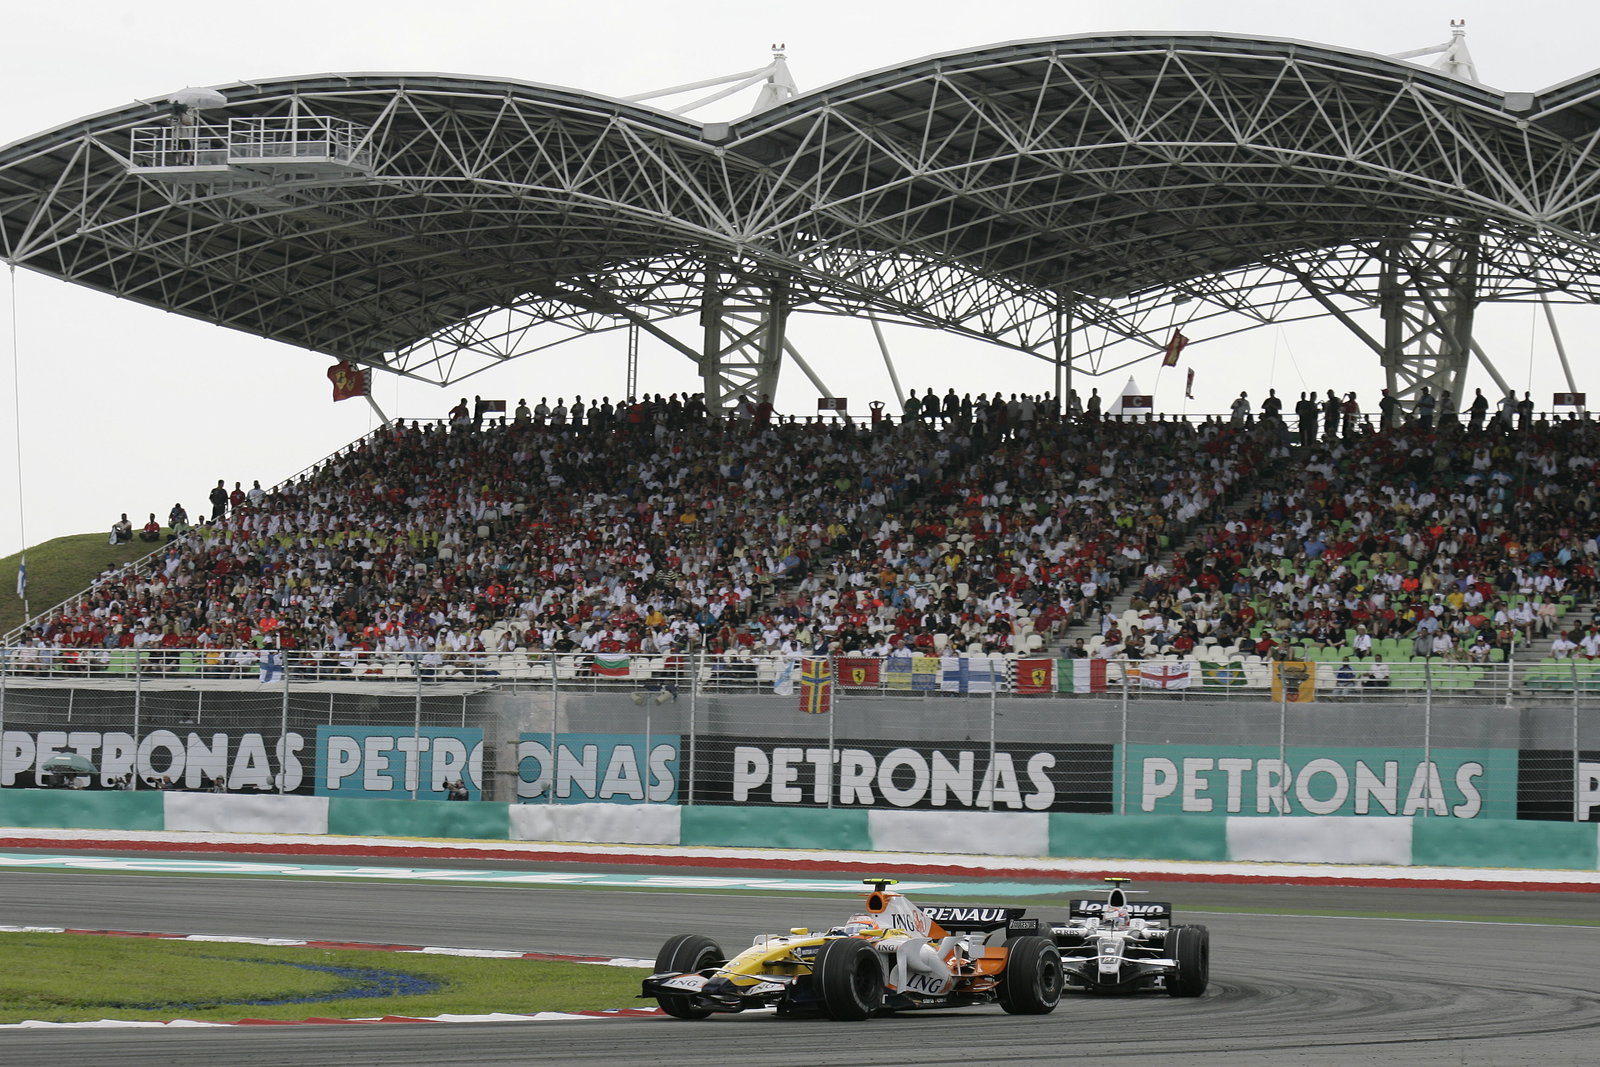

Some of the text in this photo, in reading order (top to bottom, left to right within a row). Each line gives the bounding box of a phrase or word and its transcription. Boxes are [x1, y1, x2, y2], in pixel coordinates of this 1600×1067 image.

[828, 399, 837, 409] B
[1133, 396, 1143, 407] C
[1564, 394, 1575, 405] D
[488, 401, 497, 411] A
[1, 730, 304, 793] PETRONAS
[732, 745, 1057, 810] PETRONAS
[1141, 756, 1484, 819] PETRONAS
[923, 907, 1007, 922] RENAUL
[891, 913, 915, 932] ING
[878, 944, 895, 952] ING
[669, 979, 698, 987] ING
[749, 982, 776, 994] ING
[906, 973, 943, 993] ING
